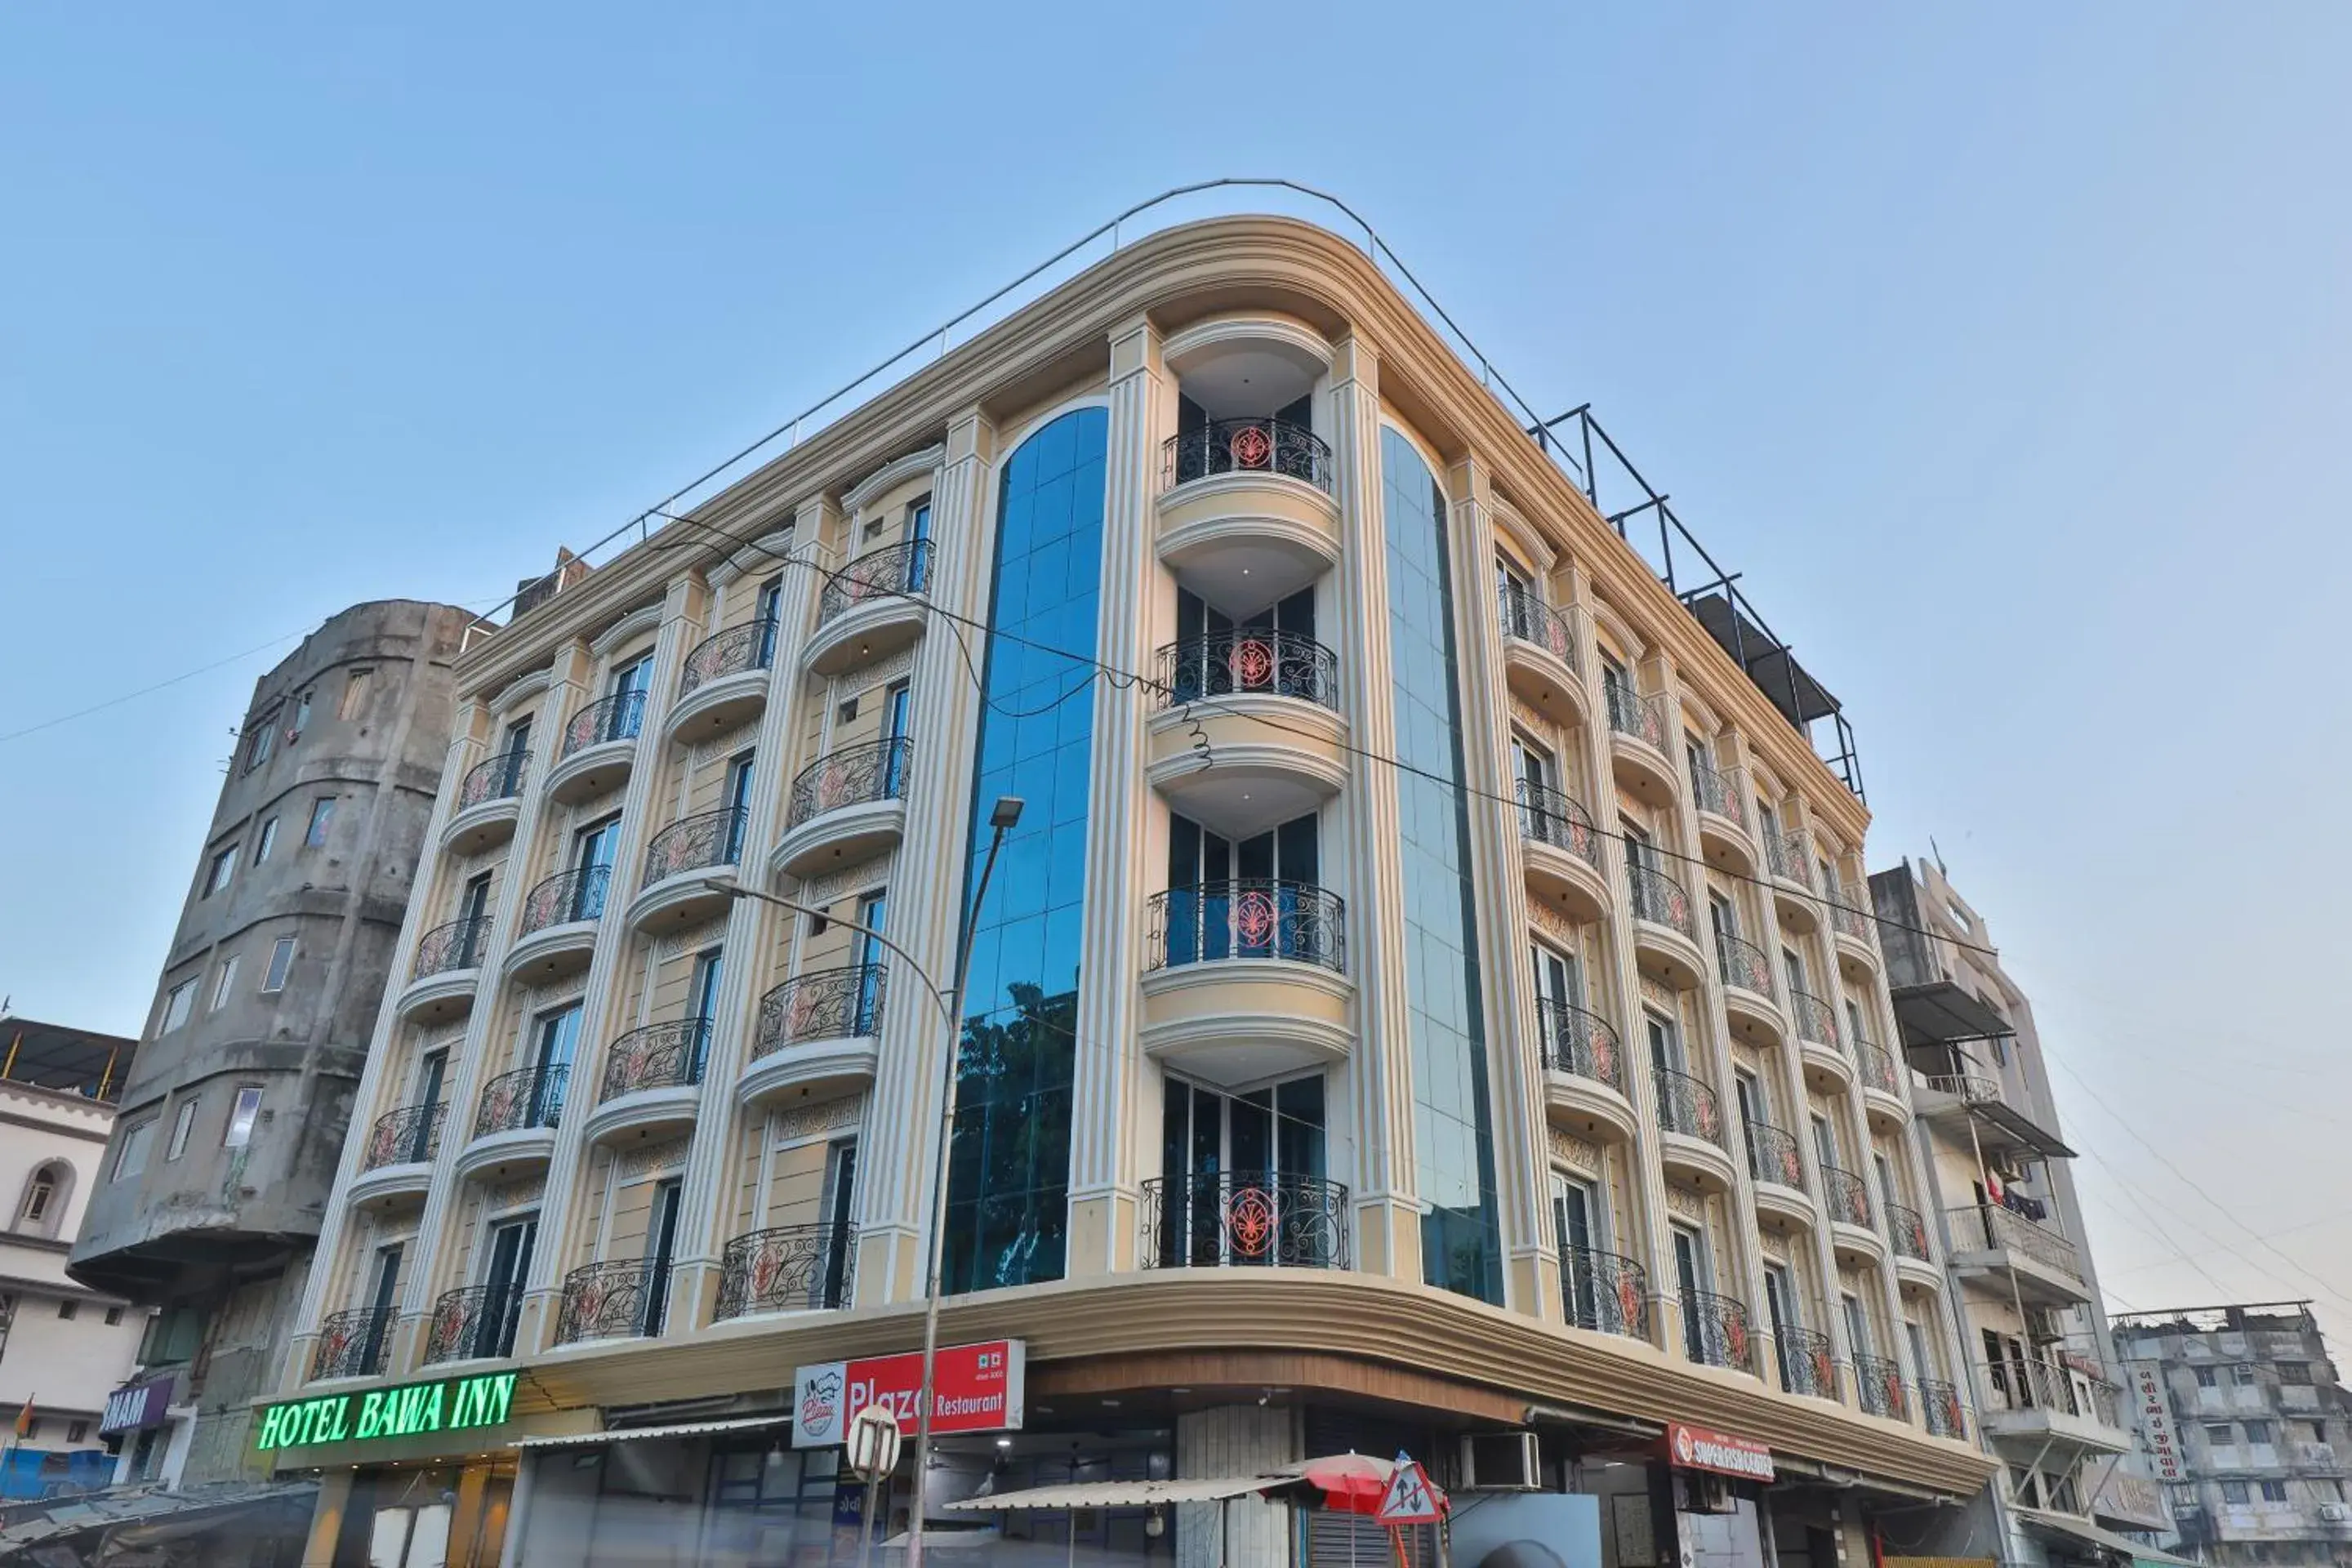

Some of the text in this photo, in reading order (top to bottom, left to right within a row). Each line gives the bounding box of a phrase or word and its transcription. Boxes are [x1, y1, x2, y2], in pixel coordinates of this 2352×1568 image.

[258, 1374, 516, 1450] HOTEL BAWA INN
[937, 1392, 1003, 1417] Restaurant
